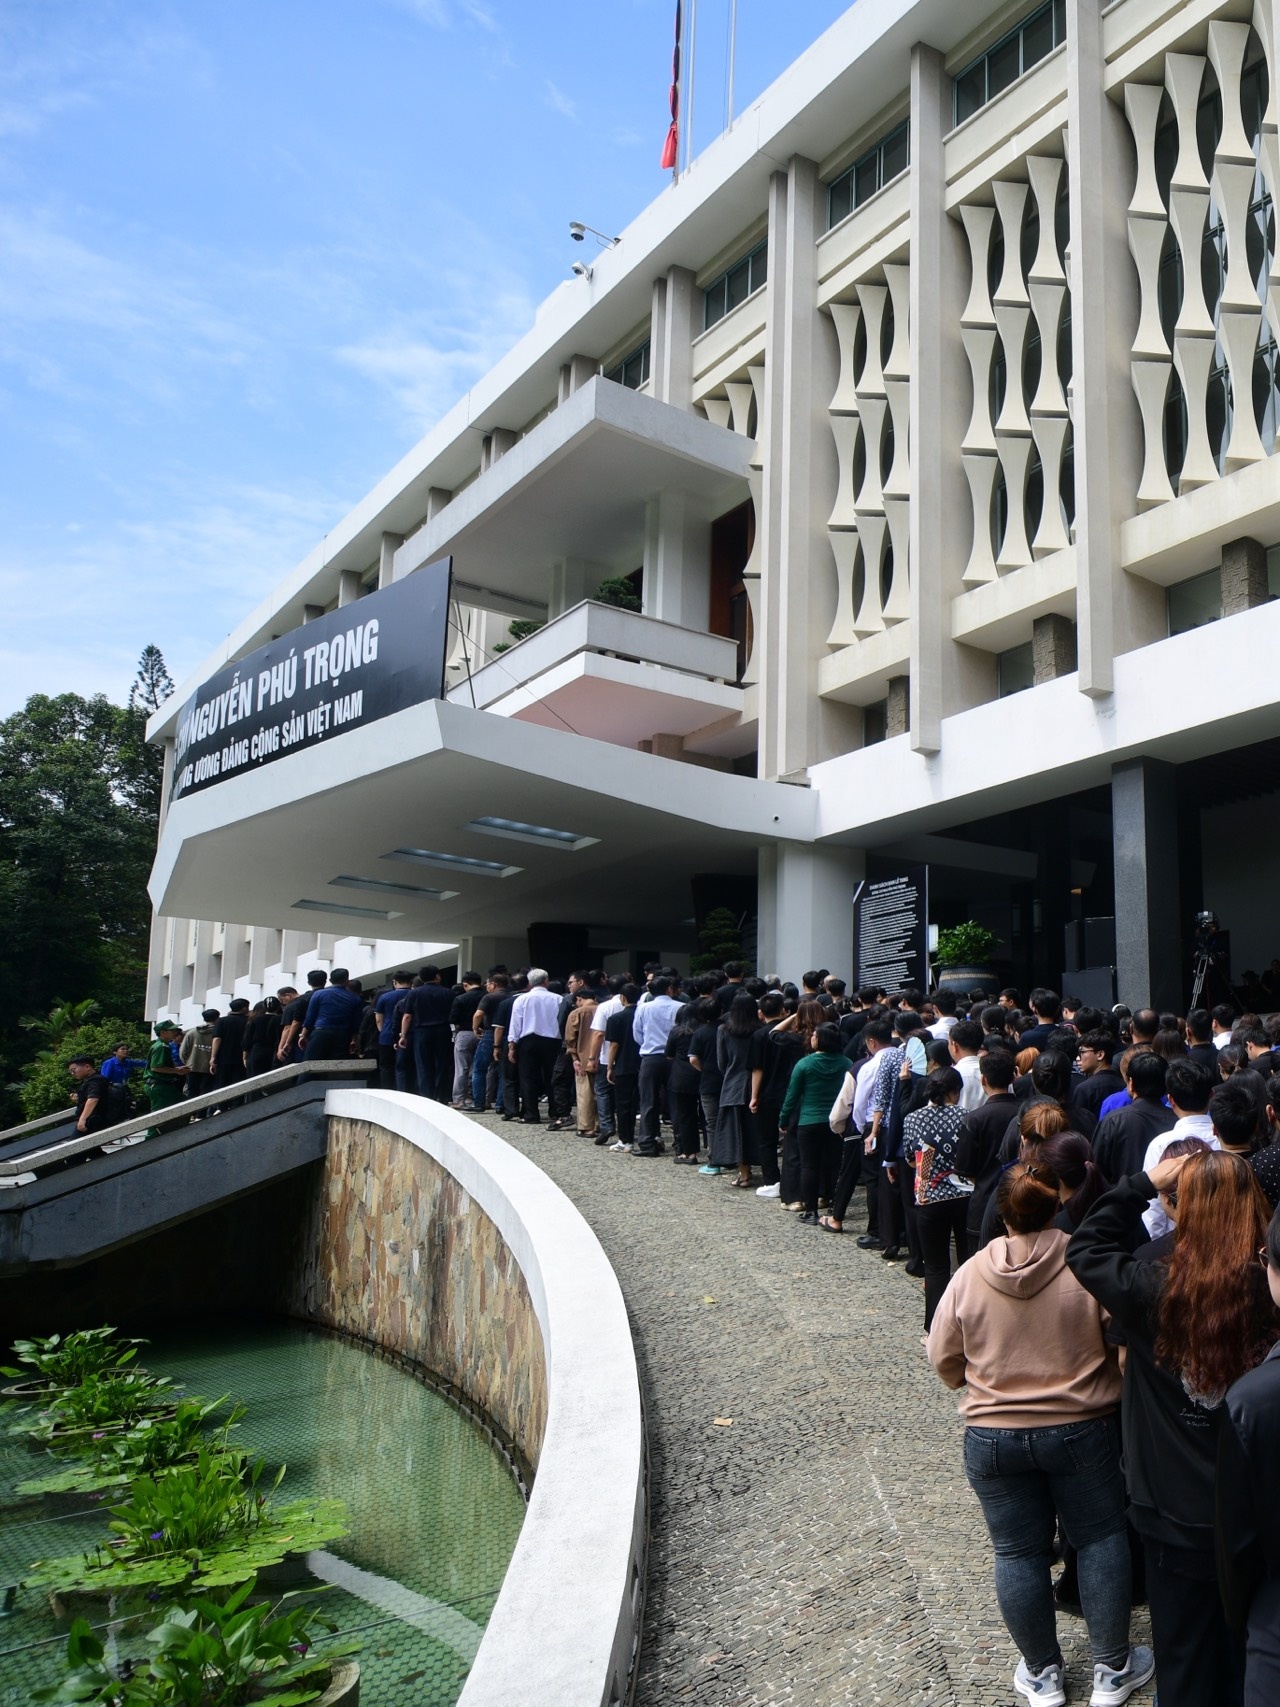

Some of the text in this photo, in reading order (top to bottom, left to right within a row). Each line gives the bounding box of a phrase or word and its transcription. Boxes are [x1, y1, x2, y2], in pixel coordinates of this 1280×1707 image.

[187, 671, 253, 748] NGUYỄN
[257, 648, 298, 712] PHÚ
[303, 618, 379, 690] TRỌNG
[194, 751, 221, 784] ƯƠNG
[221, 736, 249, 772] ĐẢNG
[250, 726, 280, 763] CỘNG
[281, 709, 305, 748] SẢN
[307, 700, 332, 738] VIỆT
[333, 689, 364, 727] NAM
